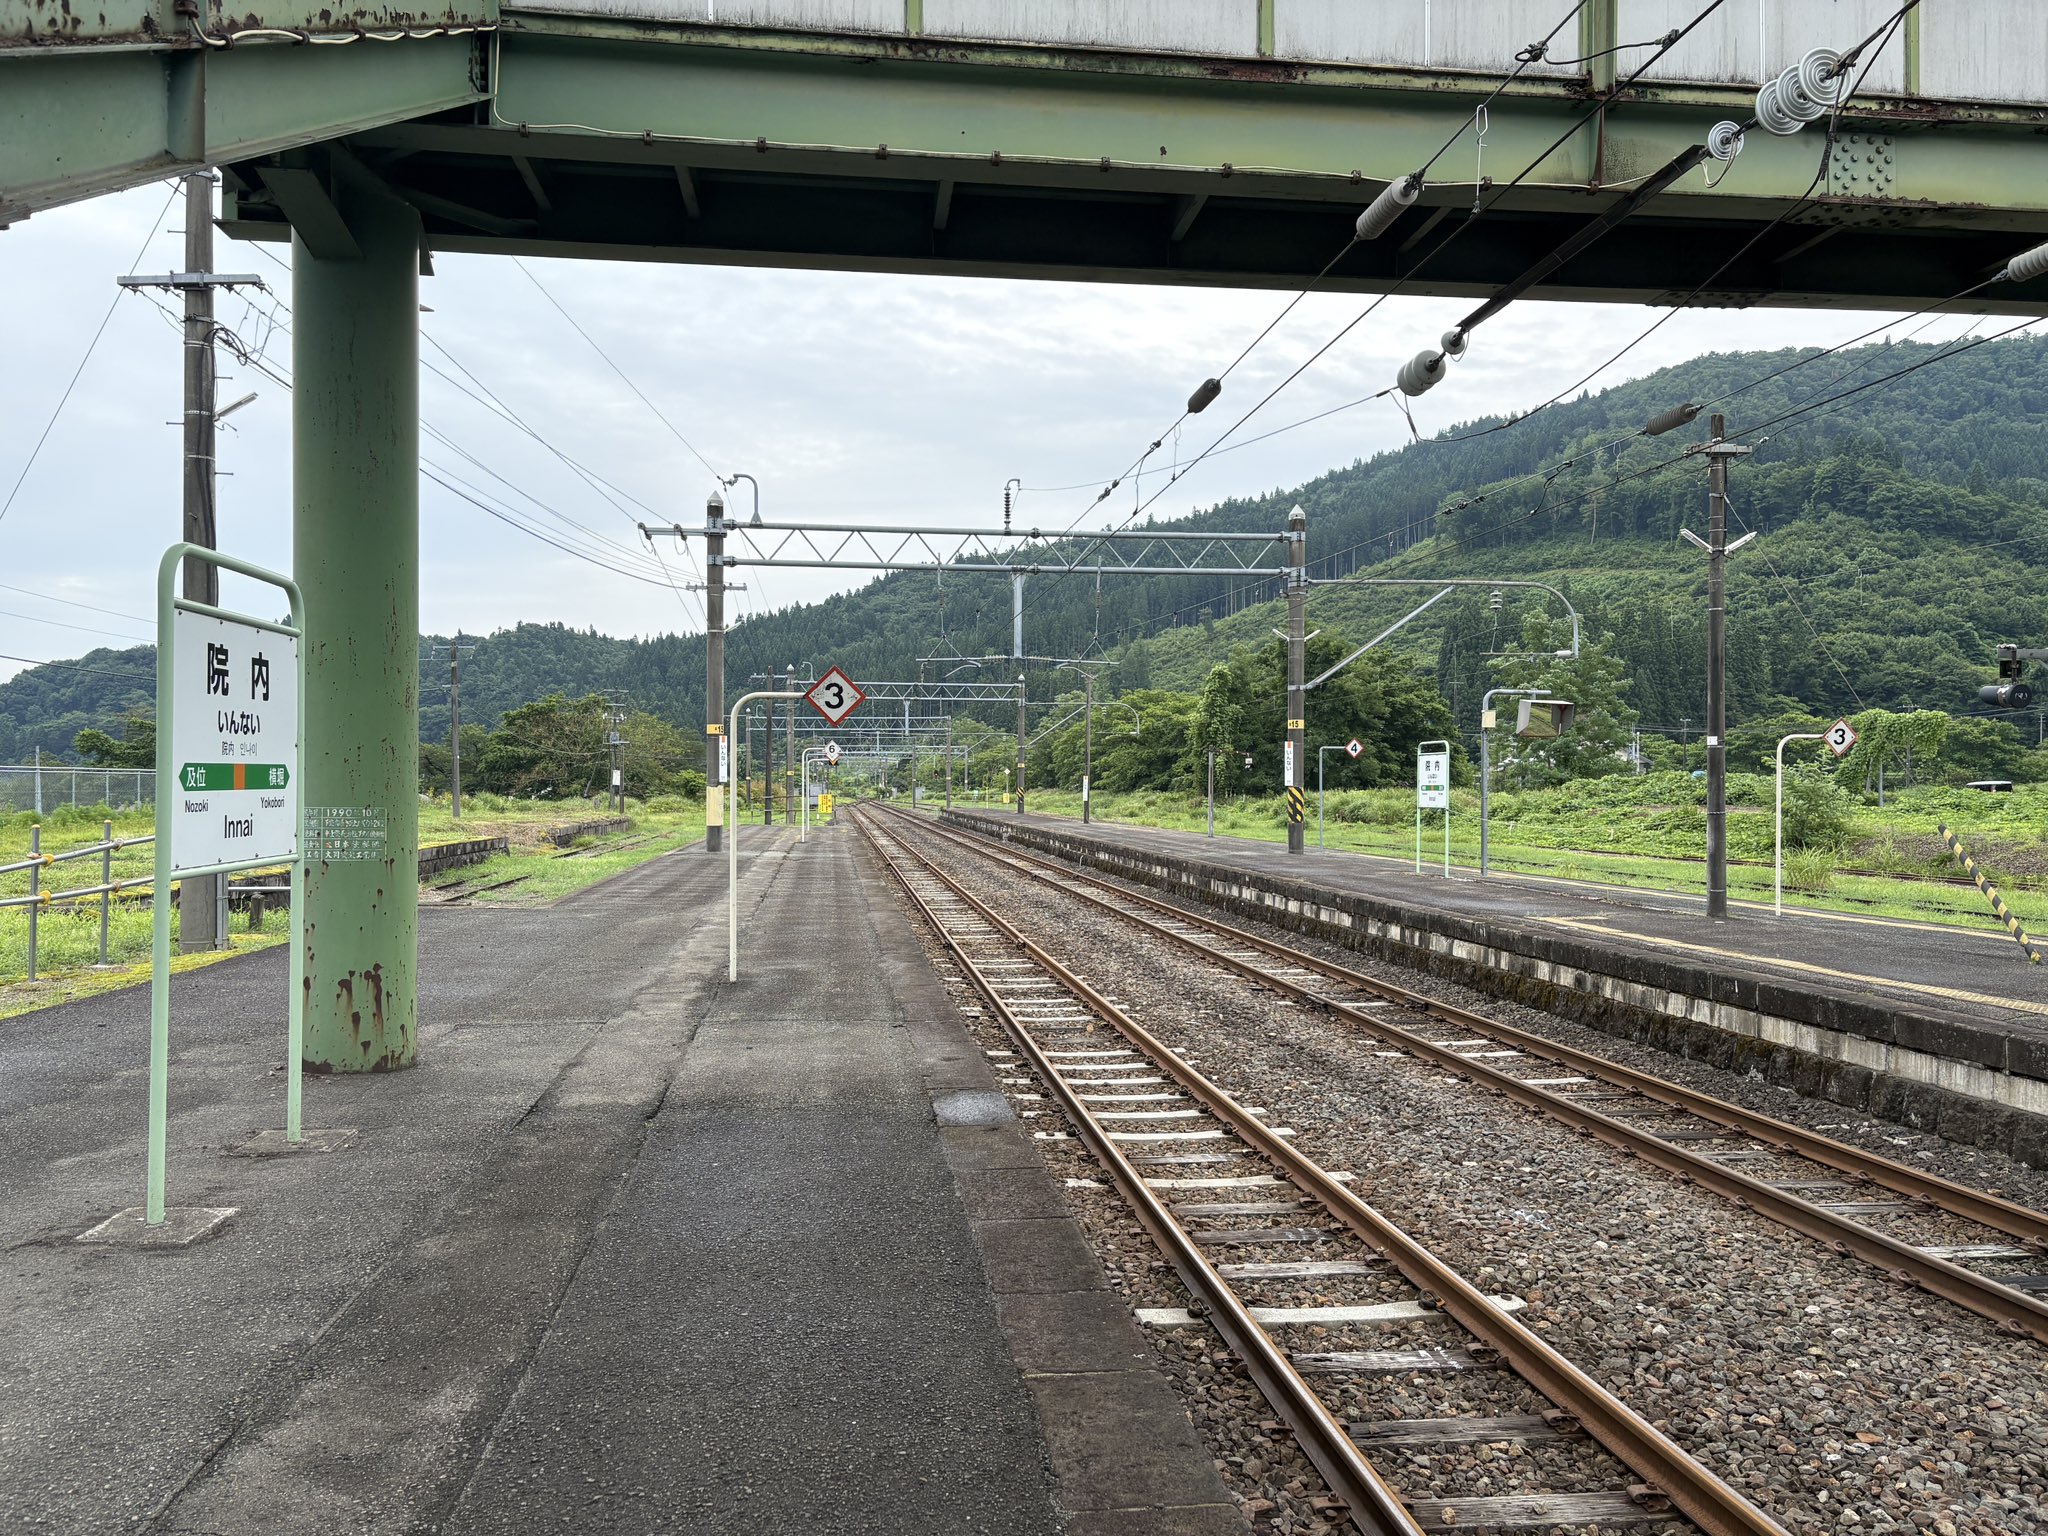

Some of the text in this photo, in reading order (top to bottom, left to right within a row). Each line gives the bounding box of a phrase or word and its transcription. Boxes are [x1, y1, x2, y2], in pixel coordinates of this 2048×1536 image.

[207, 642, 270, 702] 院内
[824, 682, 844, 709] 3
[218, 710, 261, 735] いんない
[1833, 728, 1846, 745] 3
[829, 745, 835, 753] 6
[1351, 743, 1358, 753] 4
[186, 766, 207, 788] 及位
[269, 767, 285, 787] 横堀
[185, 799, 209, 813] Nozoki
[260, 795, 285, 809] Yokobori
[224, 813, 253, 839] Innai
